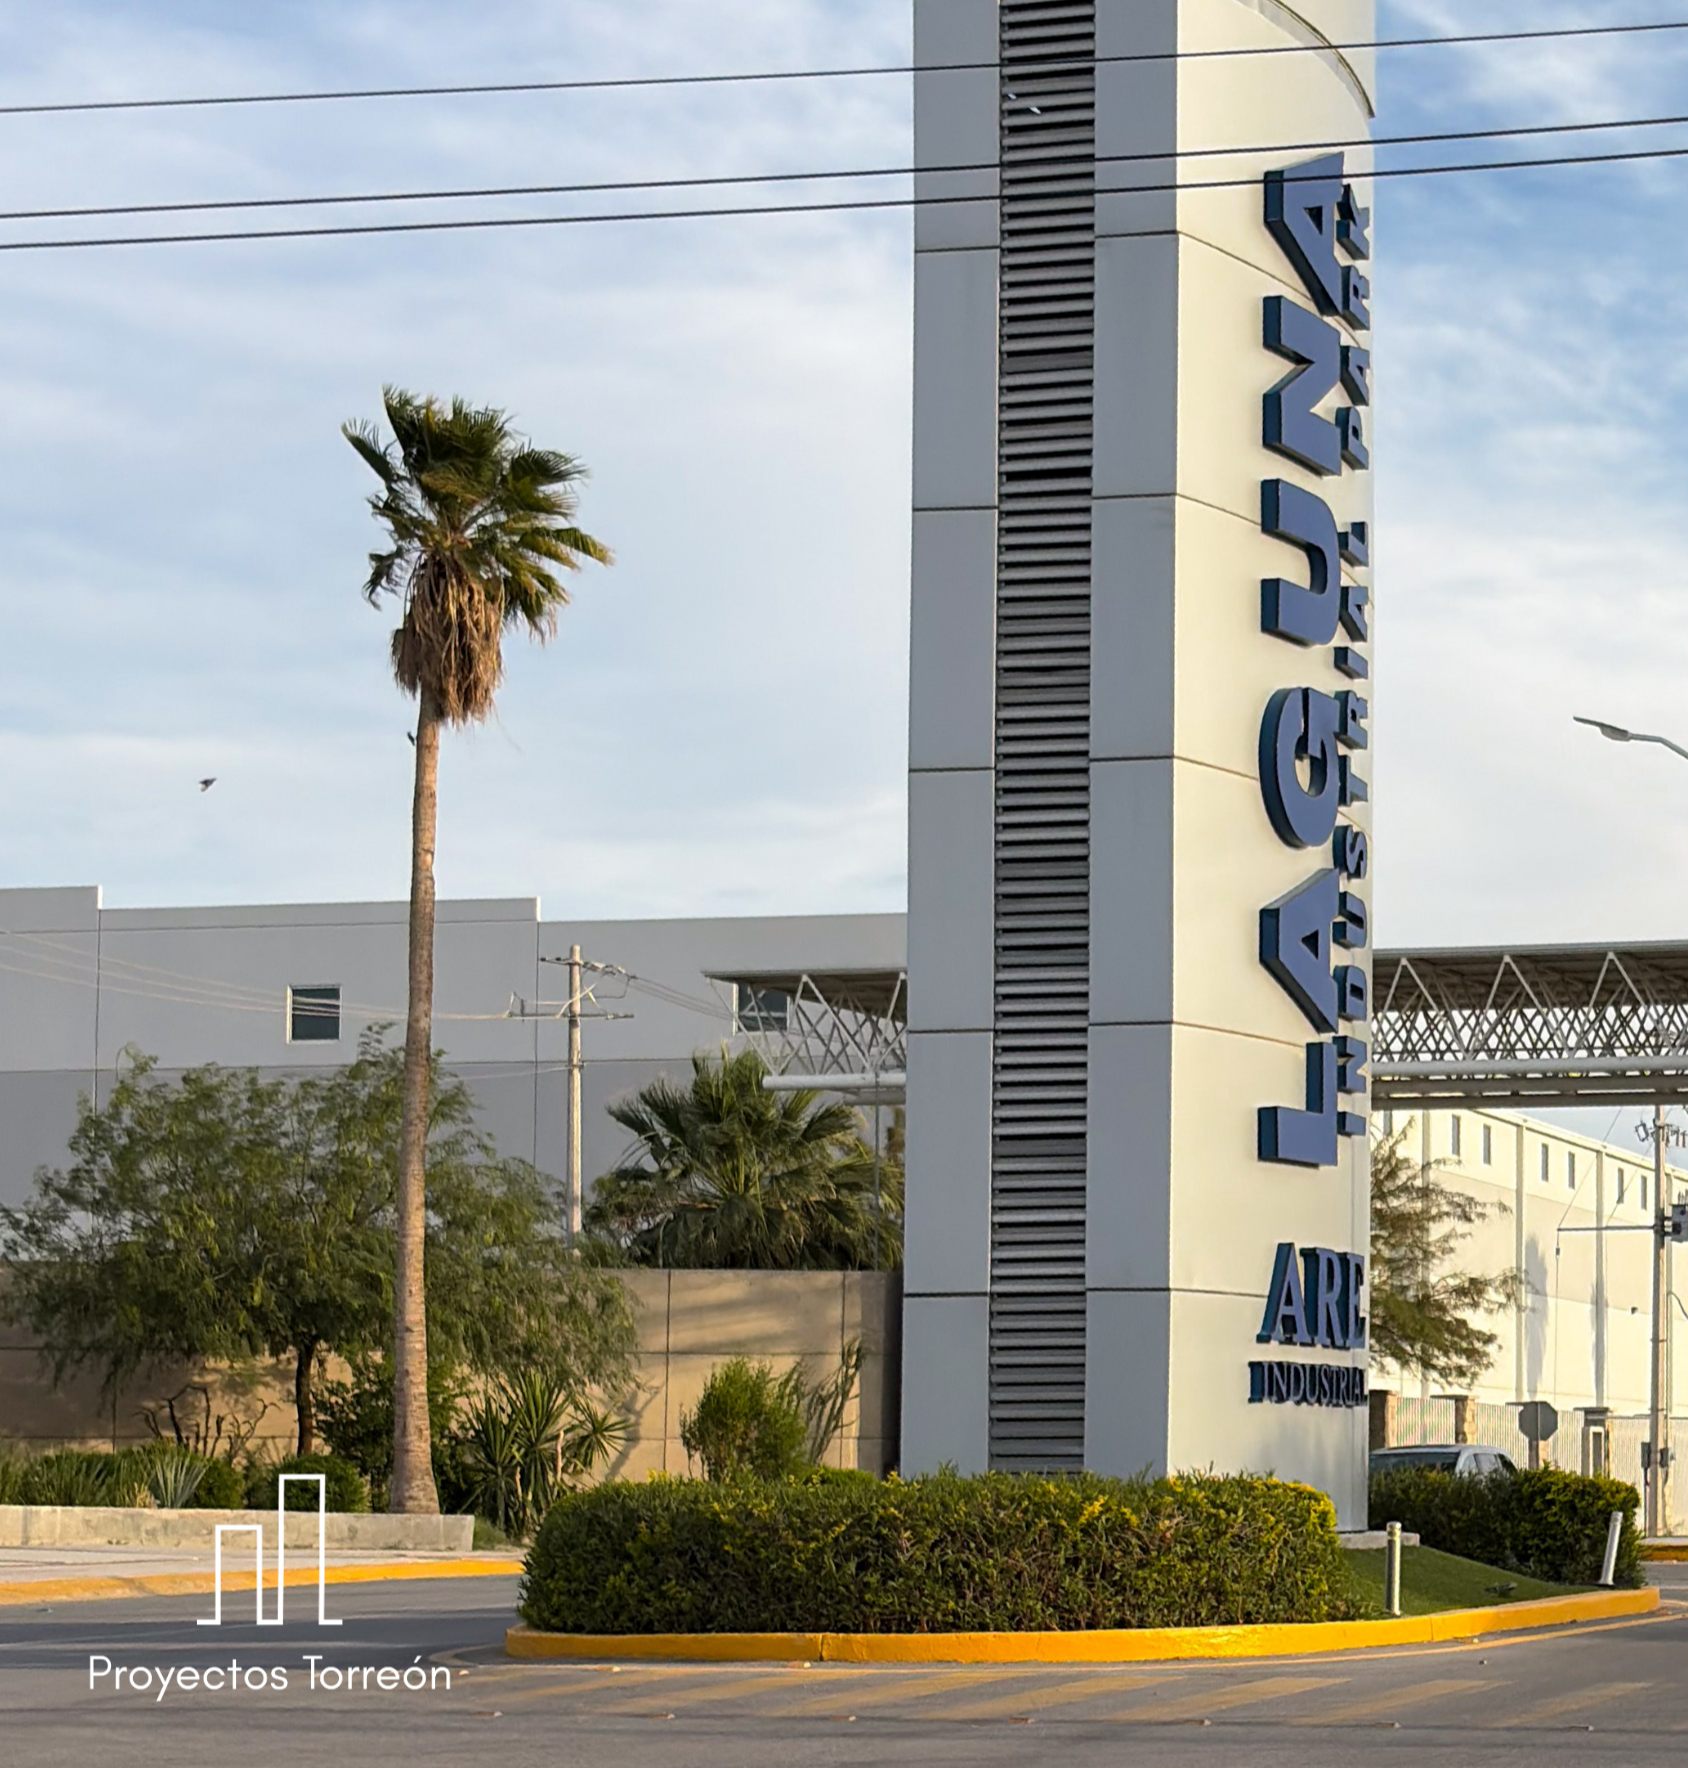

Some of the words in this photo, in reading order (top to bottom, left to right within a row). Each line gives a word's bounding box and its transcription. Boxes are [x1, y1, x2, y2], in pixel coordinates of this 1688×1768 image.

[1335, 184, 1370, 470] PARK
[1258, 151, 1345, 1168] LAGUNA
[1332, 521, 1369, 1137] INDUSTRIAL
[1257, 1243, 1366, 1349] ARE
